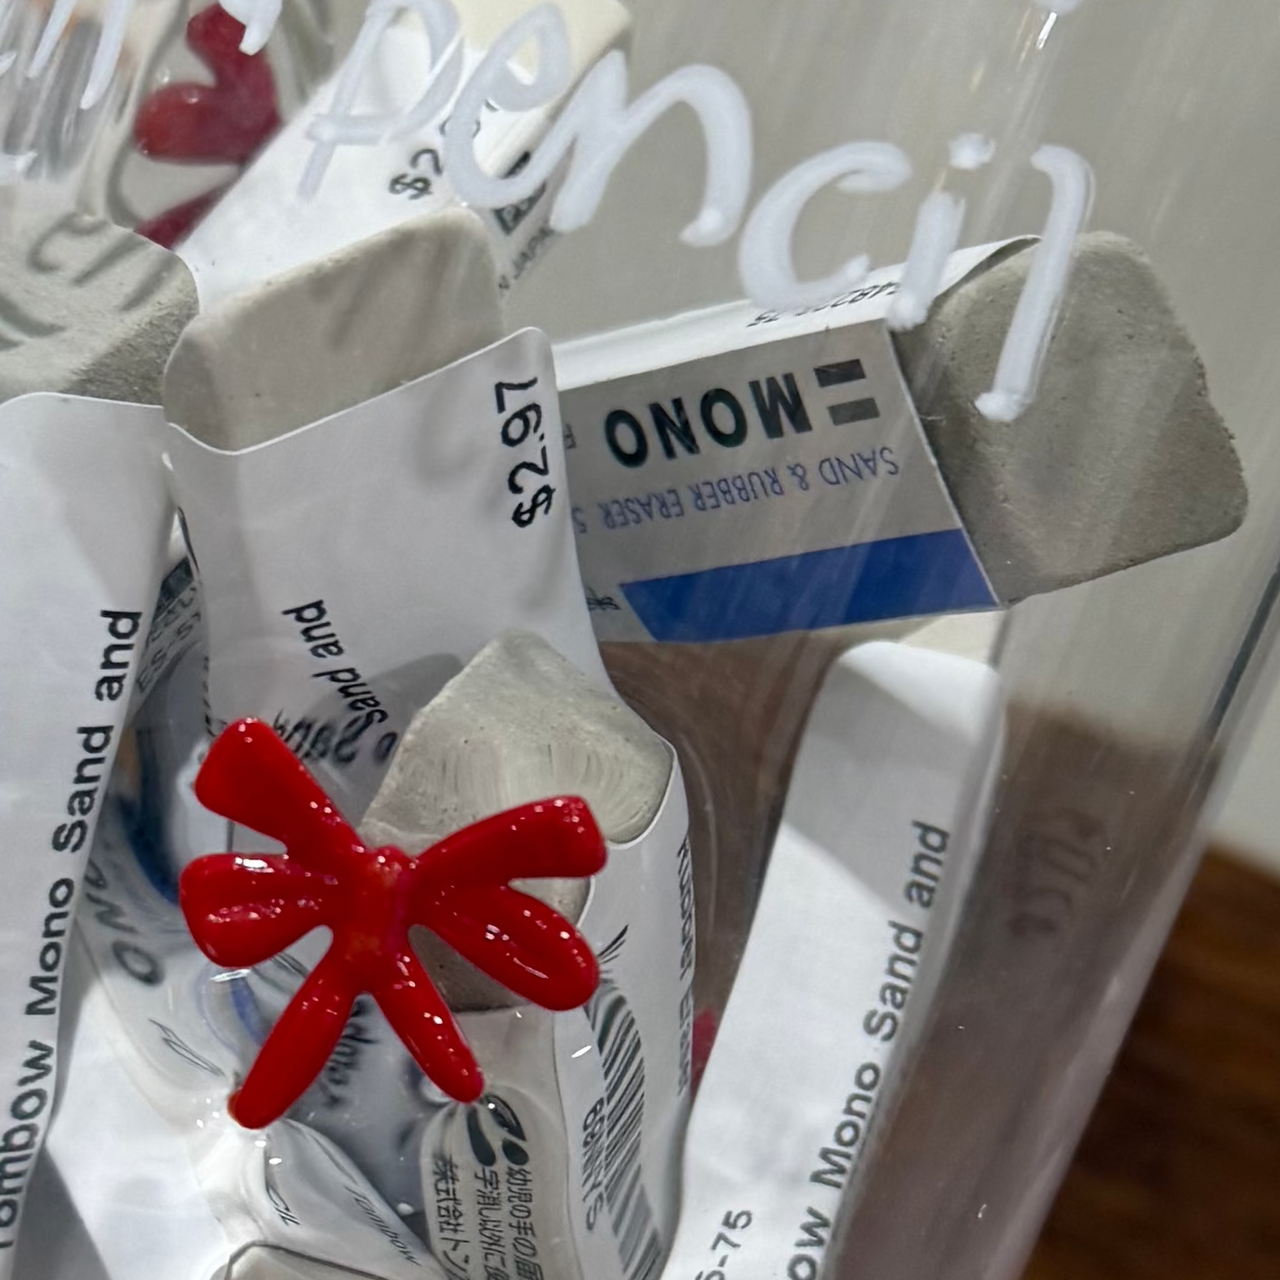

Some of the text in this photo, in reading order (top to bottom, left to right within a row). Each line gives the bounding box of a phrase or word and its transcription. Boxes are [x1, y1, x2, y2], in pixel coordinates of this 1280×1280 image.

[494, 375, 557, 530] $2.97
[603, 371, 814, 470] MONO
[687, 464, 784, 513] RUBBER
[787, 463, 811, 492] &
[818, 445, 900, 489] SAND
[598, 487, 685, 532] ERASER
[281, 598, 346, 660] and
[24, 876, 75, 1018] Mono
[51, 723, 115, 855] Sand
[94, 608, 143, 703] and
[810, 1059, 882, 1192] Mono
[863, 918, 925, 1043] Sand
[900, 819, 952, 912] and
[344, 1185, 423, 1267] Tombow
